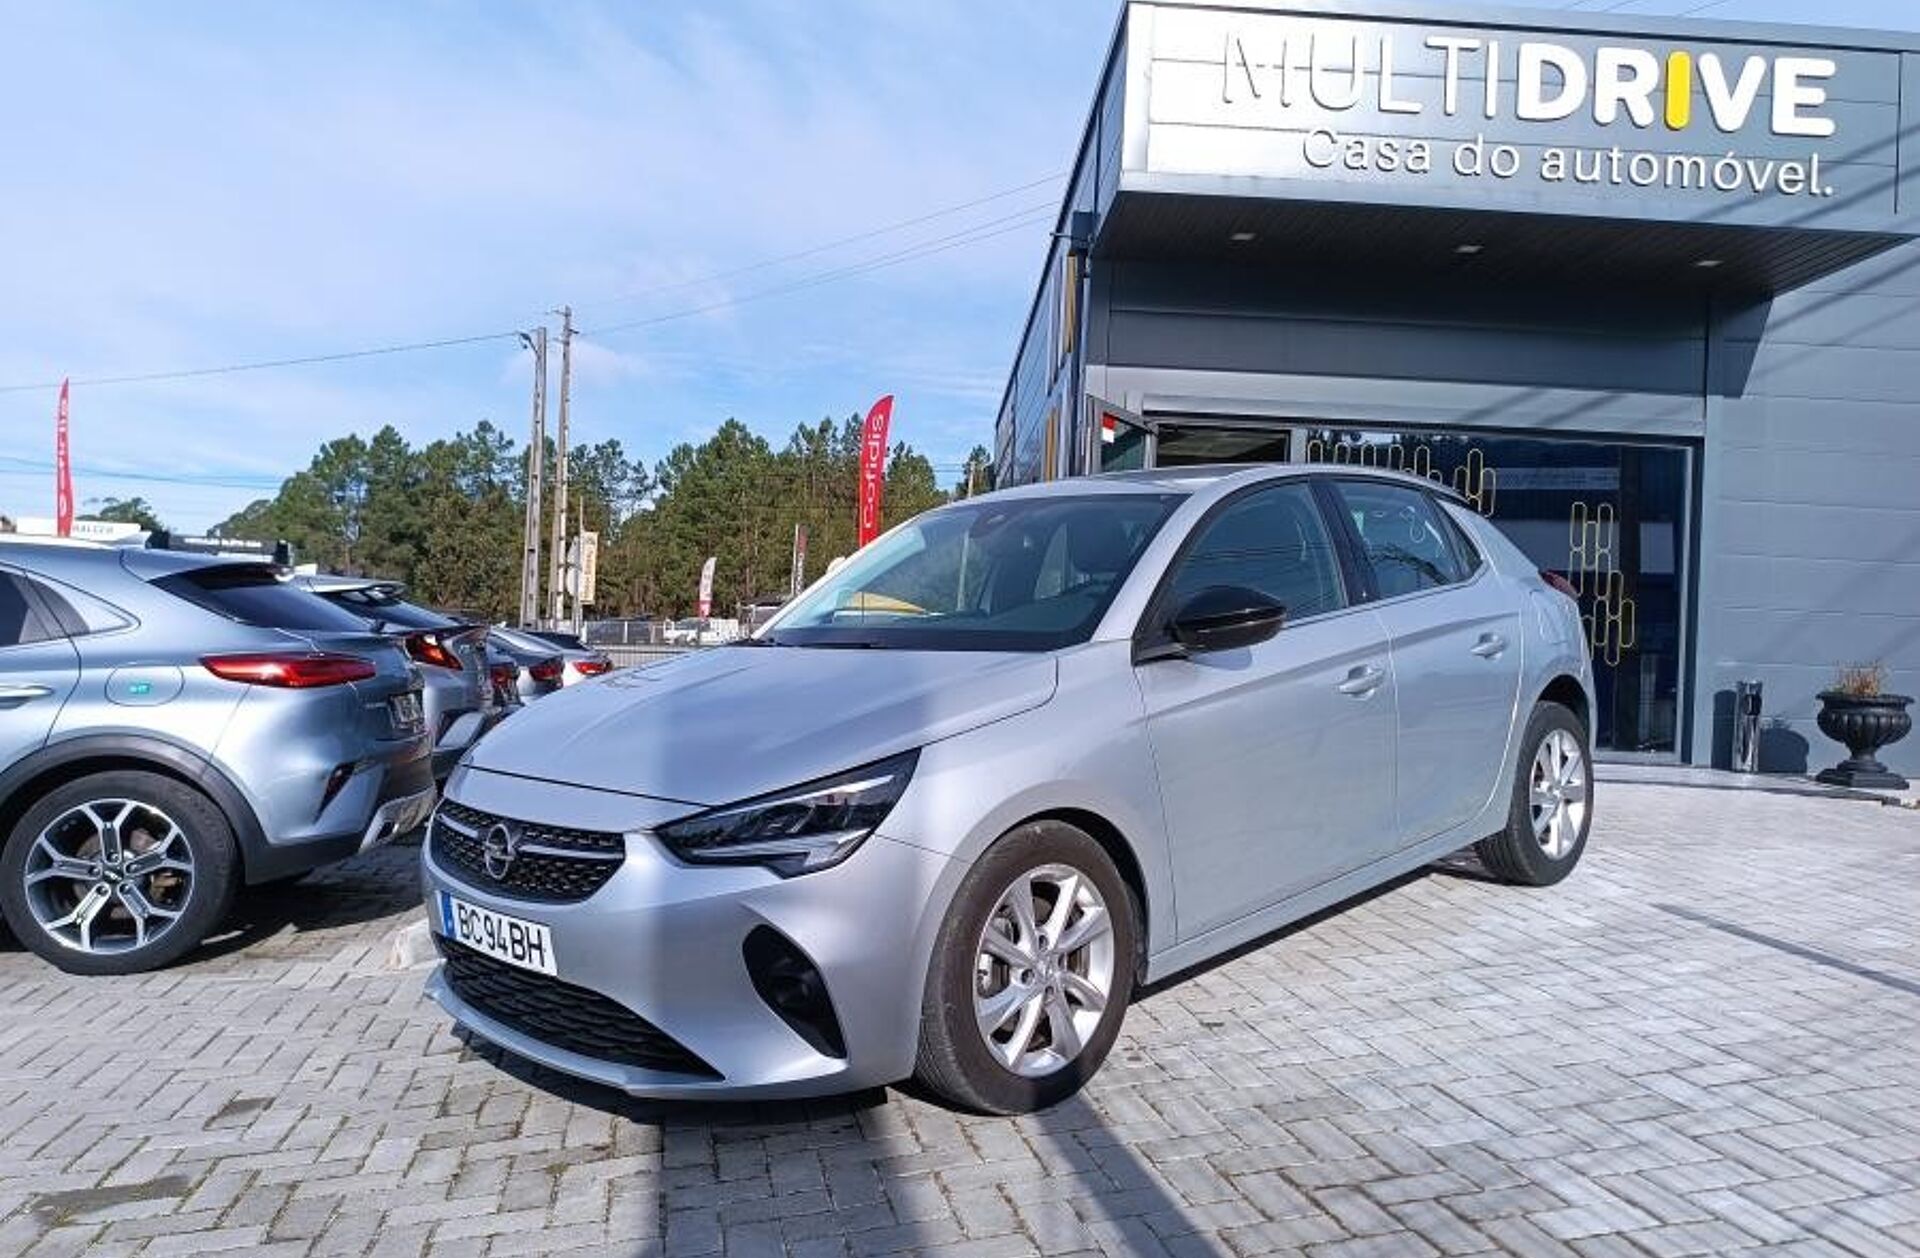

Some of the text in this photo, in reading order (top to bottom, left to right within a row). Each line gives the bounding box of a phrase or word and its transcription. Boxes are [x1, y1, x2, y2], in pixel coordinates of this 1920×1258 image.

[1223, 32, 1836, 137] MULTIDRIVE
[1303, 128, 1833, 196] Casa do automóvel.
[863, 413, 884, 529] cofidis
